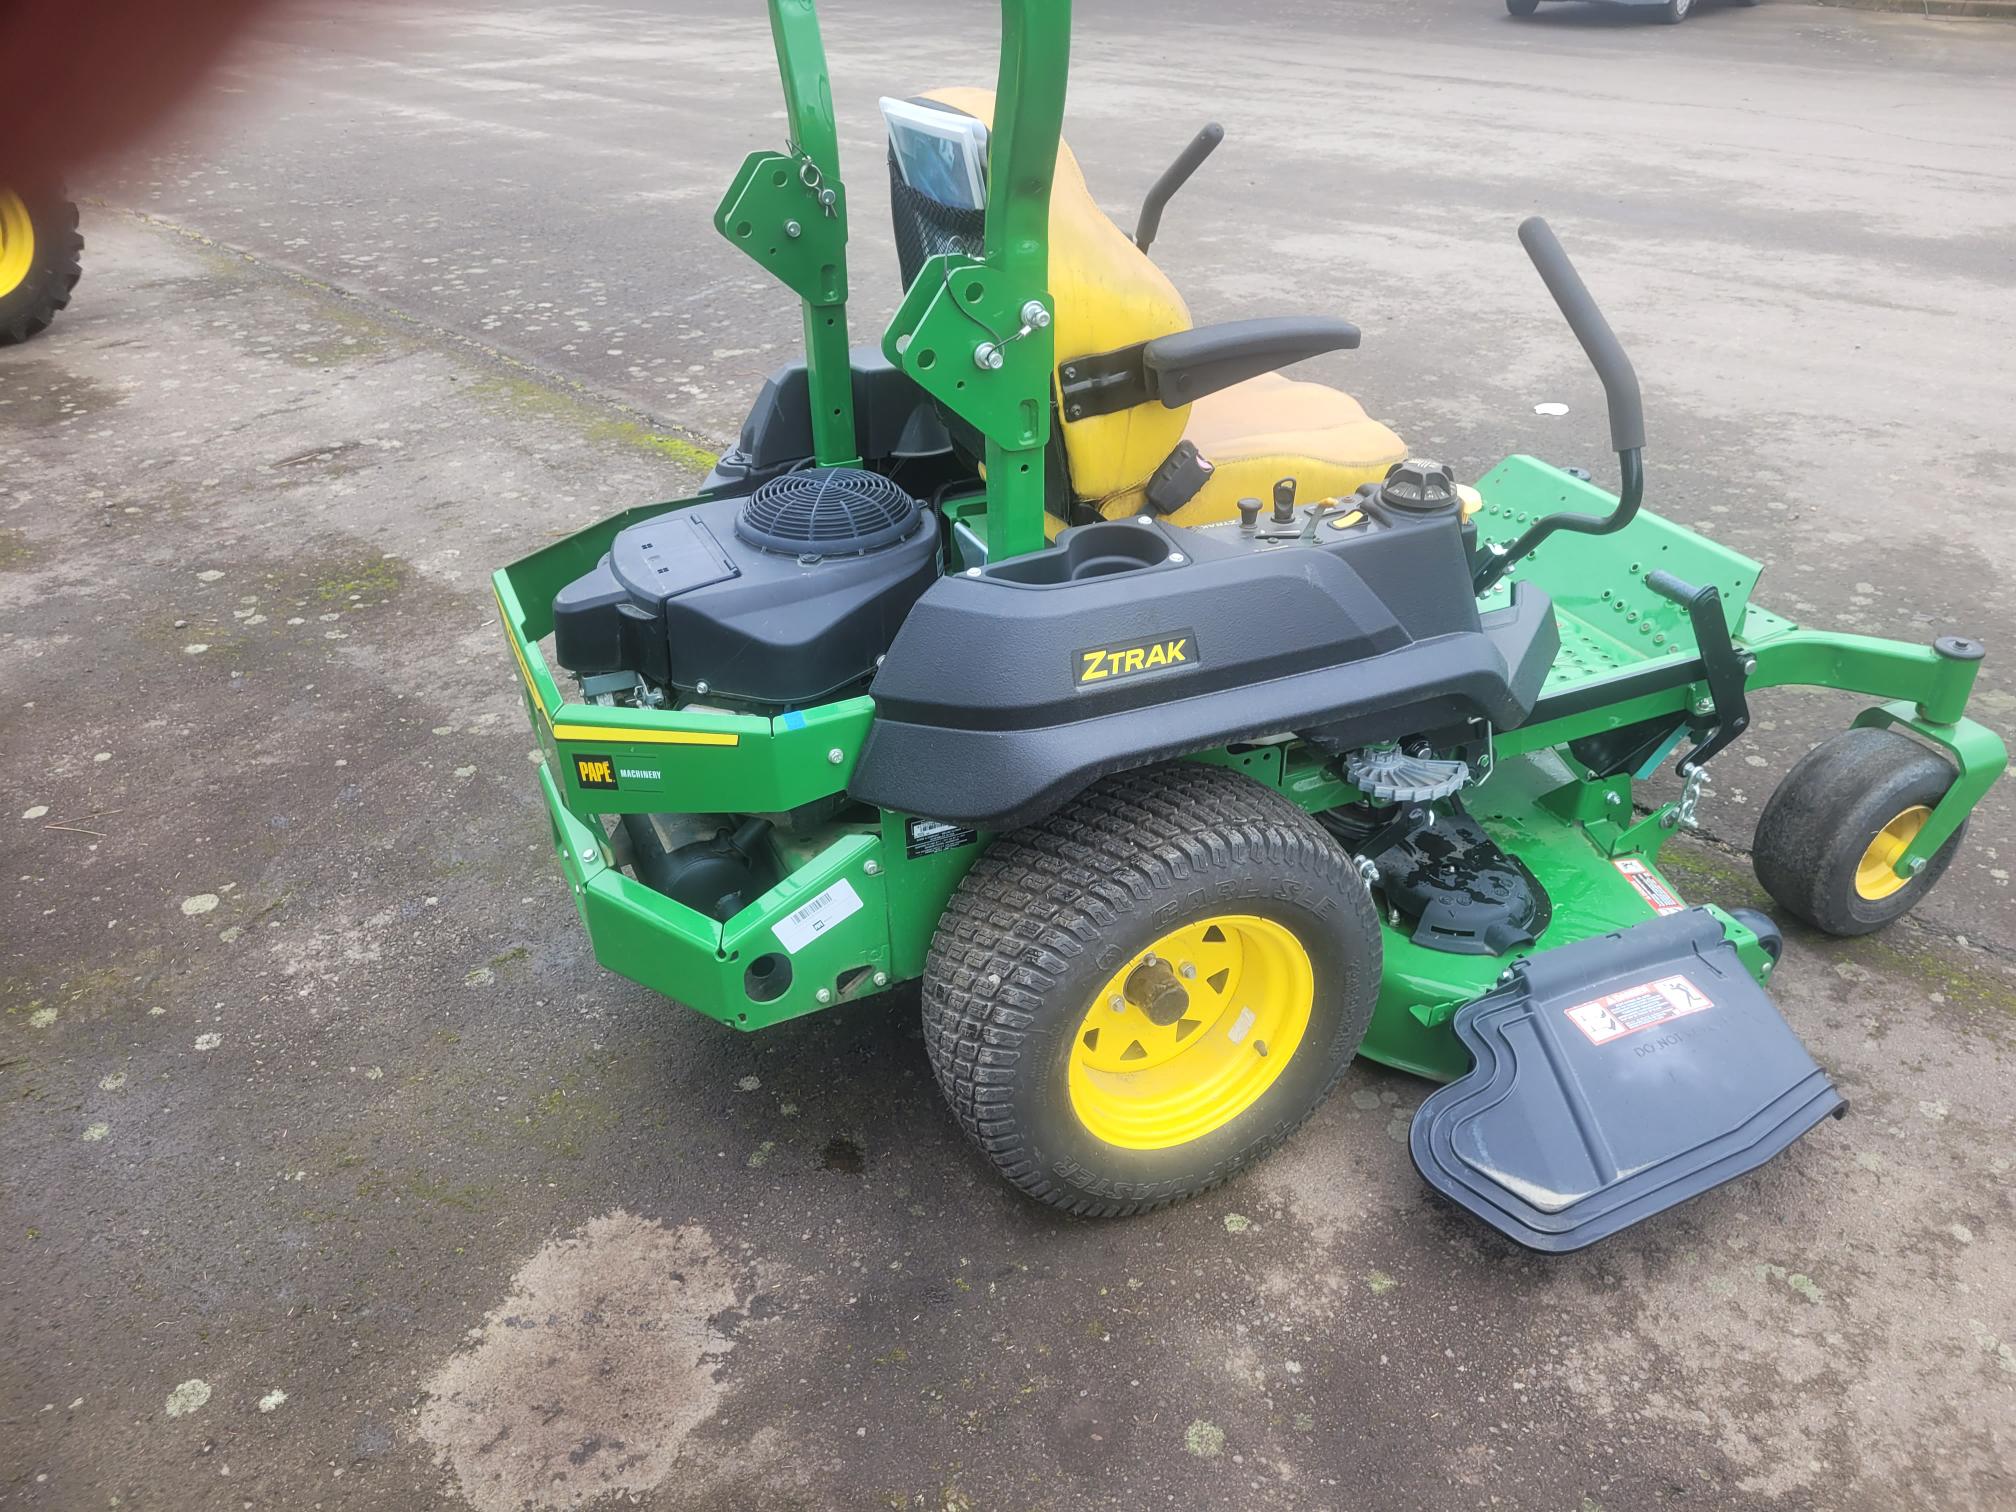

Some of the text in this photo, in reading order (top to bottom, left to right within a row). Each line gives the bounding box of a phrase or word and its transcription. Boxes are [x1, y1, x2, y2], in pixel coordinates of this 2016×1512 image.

[1082, 639, 1186, 681] ZTRAK
[620, 769, 661, 779] MACHINERY
[1152, 877, 1338, 931] CARLISLE
[1633, 1042, 1656, 1058] DO
